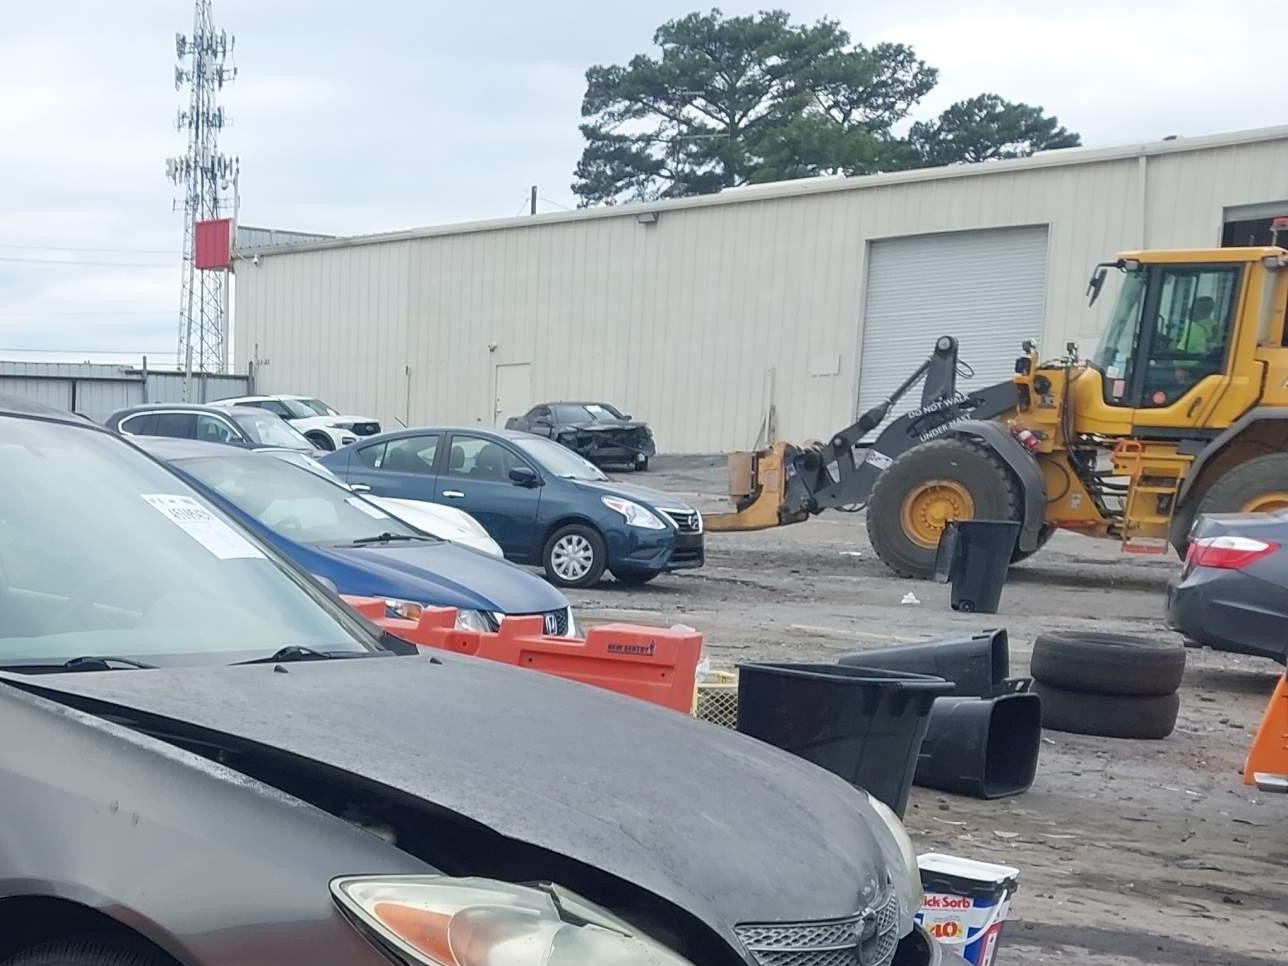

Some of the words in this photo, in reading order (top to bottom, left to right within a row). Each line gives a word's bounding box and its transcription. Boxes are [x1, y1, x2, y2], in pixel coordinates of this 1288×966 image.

[908, 408, 923, 419] DO
[922, 402, 943, 415] NOT
[943, 393, 971, 407] WALK
[919, 424, 949, 442] UNDER
[948, 413, 971, 429] MAST
[922, 896, 940, 907] ick
[942, 896, 971, 909] Sorb
